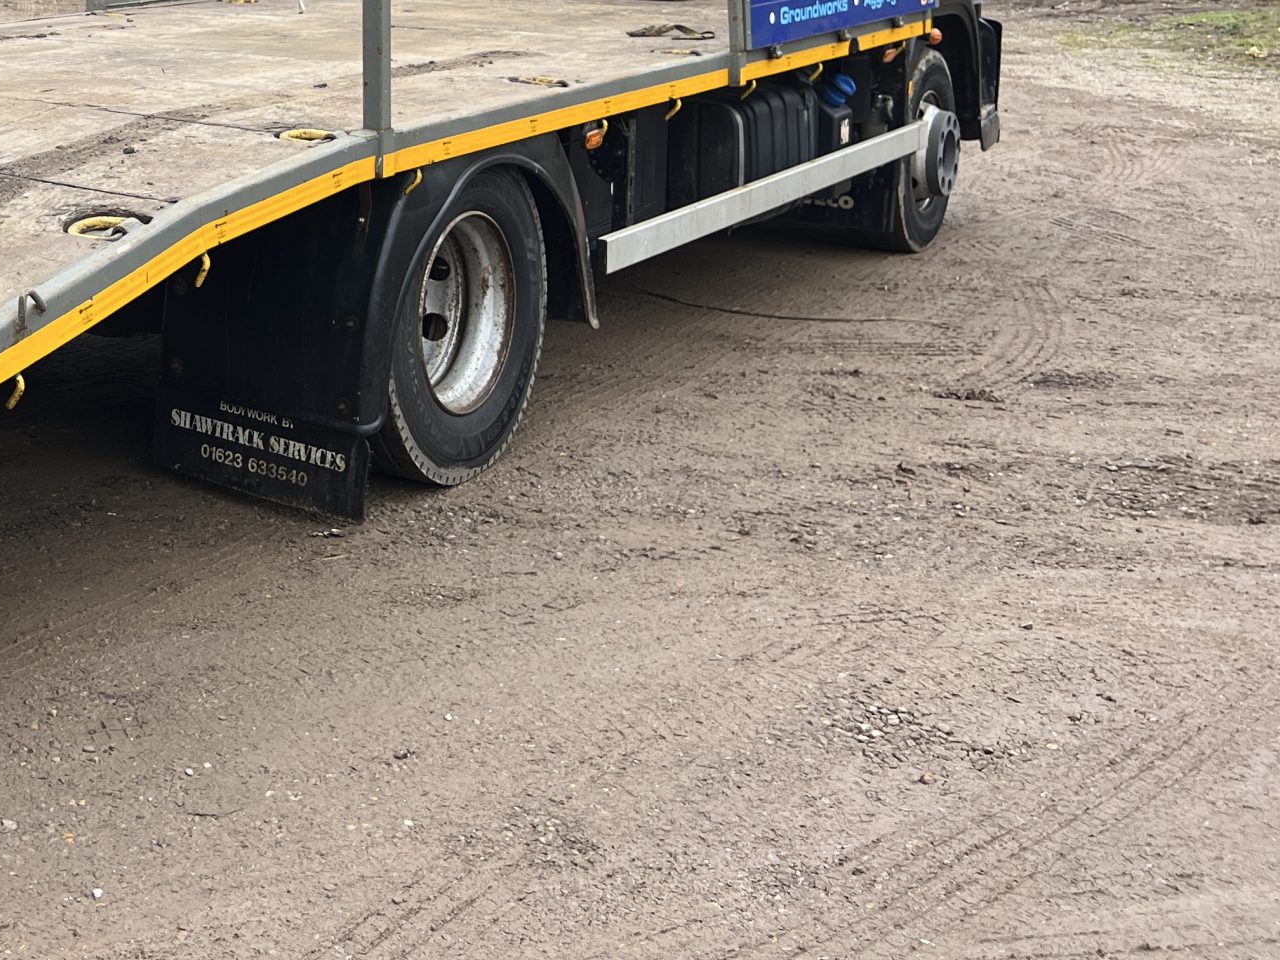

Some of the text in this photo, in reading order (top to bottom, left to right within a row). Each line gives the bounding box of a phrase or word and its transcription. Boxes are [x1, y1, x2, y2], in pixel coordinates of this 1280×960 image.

[220, 400, 279, 426] BODYWORK
[170, 408, 346, 473] SHAWTRACK SERVICES
[200, 443, 308, 487] 01623 633540
